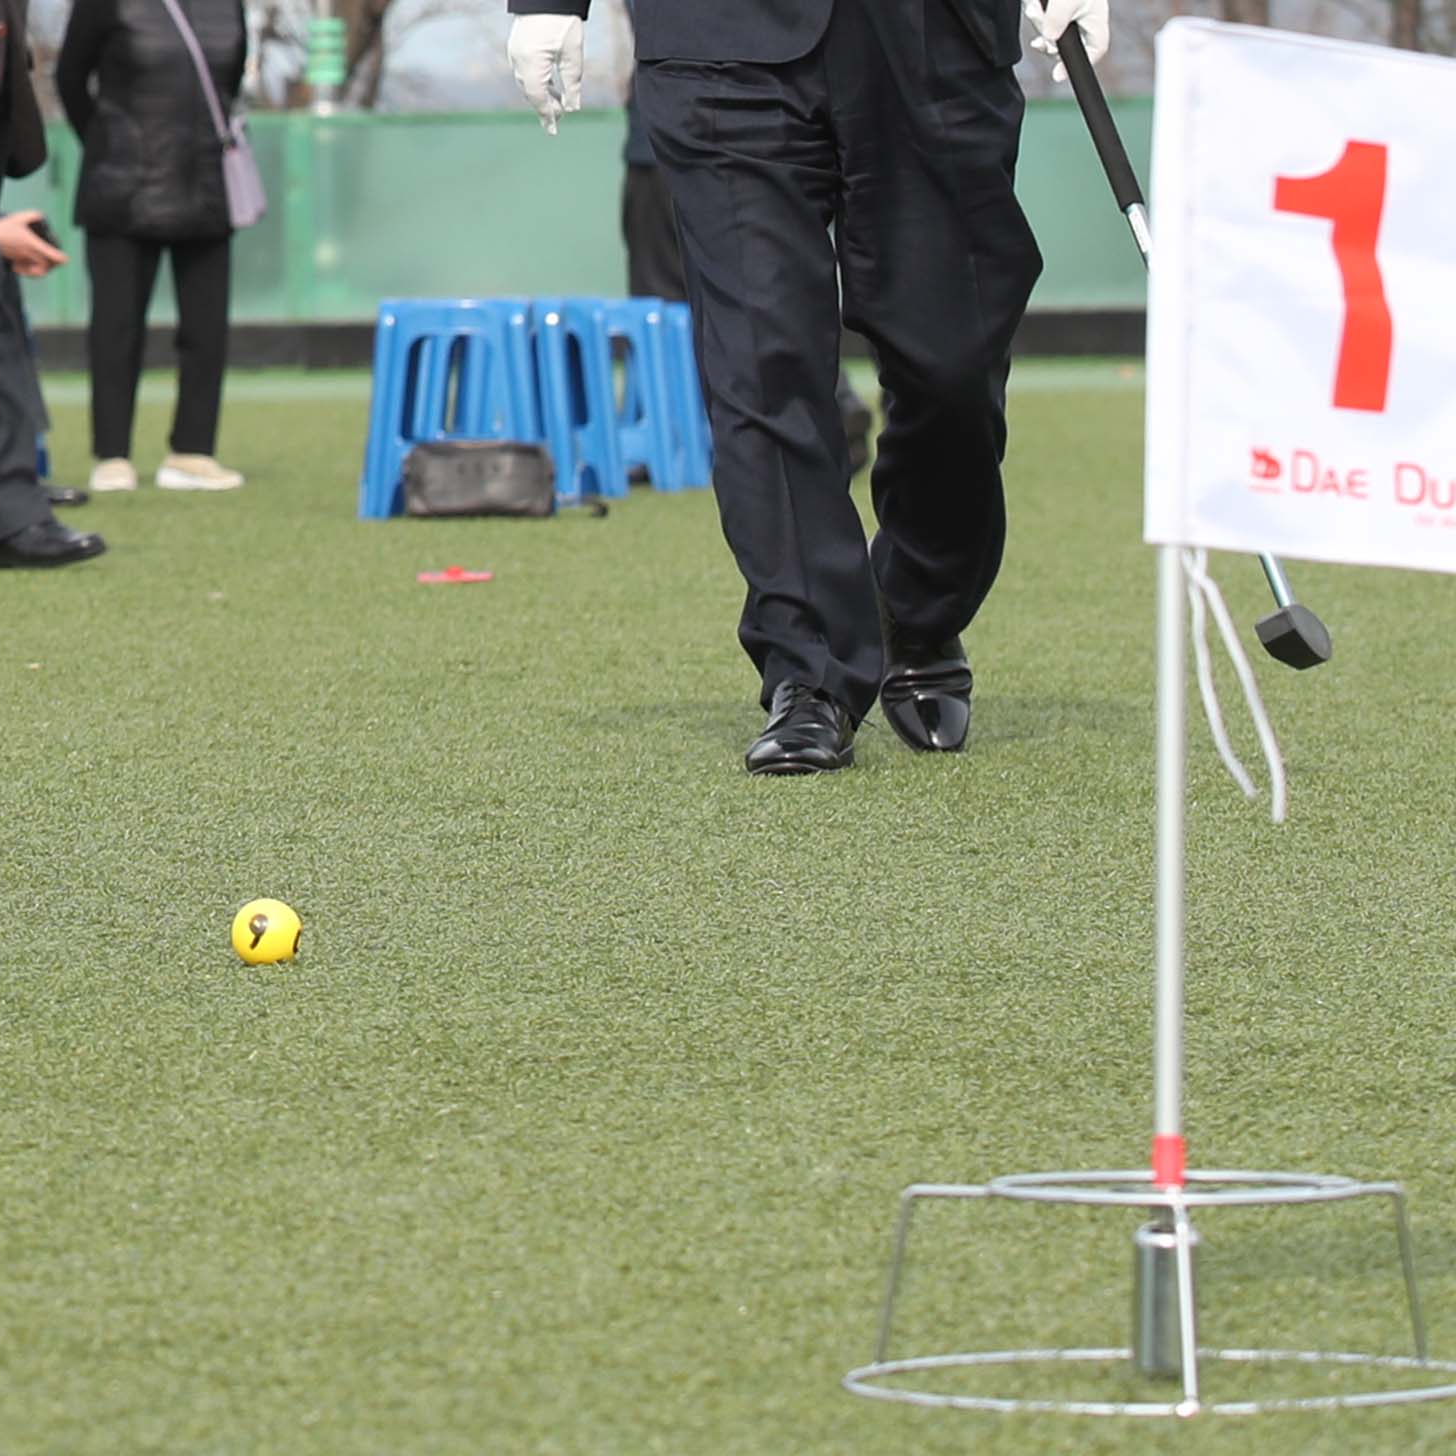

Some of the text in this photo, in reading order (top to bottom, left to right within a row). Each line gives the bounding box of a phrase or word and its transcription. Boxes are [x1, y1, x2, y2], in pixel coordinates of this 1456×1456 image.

[1272, 139, 1394, 413] 1
[1290, 448, 1456, 510] DAE DU
